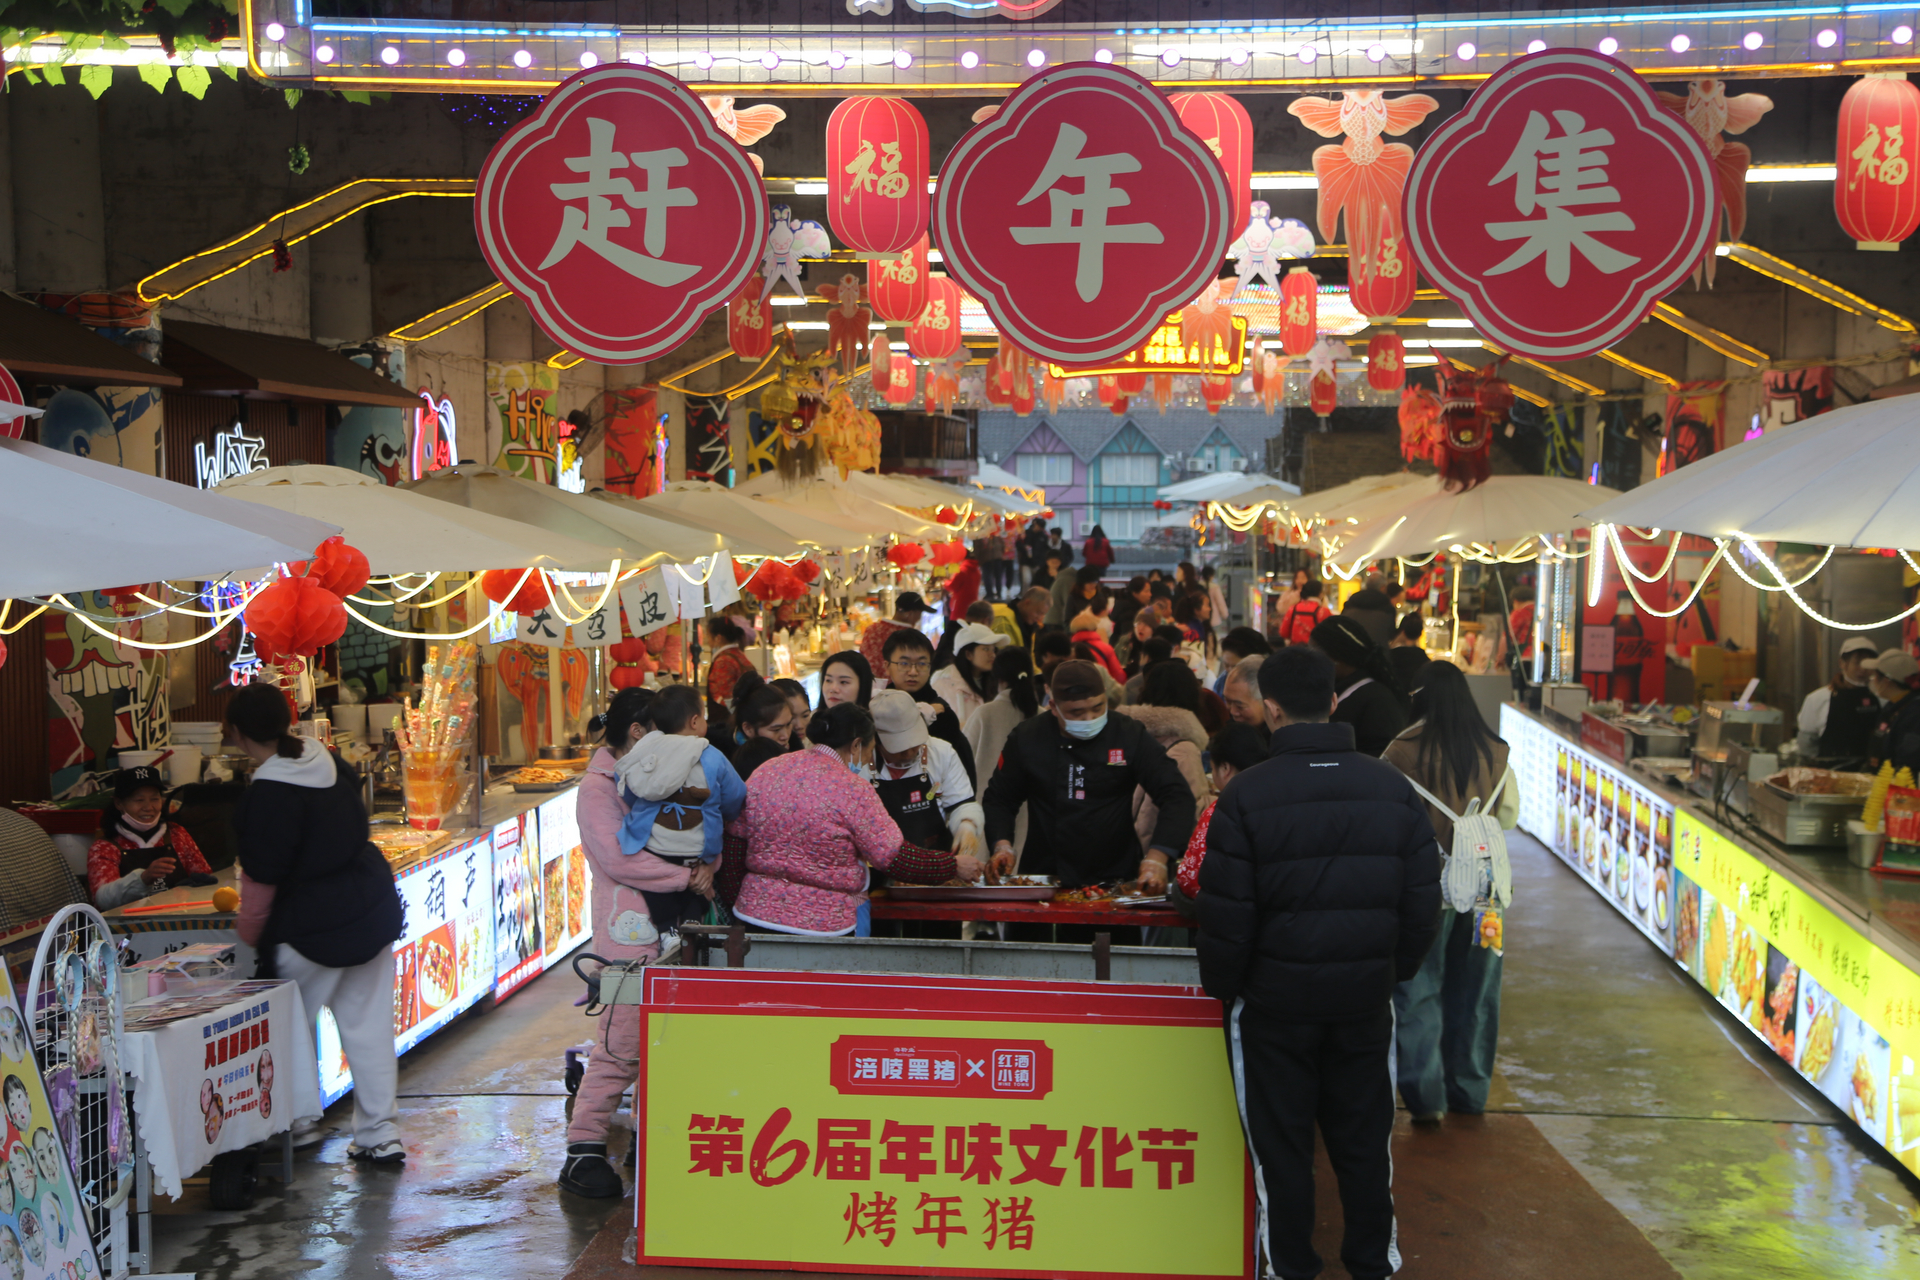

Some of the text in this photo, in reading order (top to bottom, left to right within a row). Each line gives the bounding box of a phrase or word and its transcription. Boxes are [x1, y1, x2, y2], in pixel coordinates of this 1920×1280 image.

[843, 139, 911, 206] 福
[1849, 122, 1910, 192] 福
[537, 109, 1642, 304] 赶 年 集
[877, 250, 919, 289] 福
[735, 298, 765, 333] 福
[912, 299, 951, 334] 福
[1284, 294, 1311, 332] 福
[1372, 348, 1399, 375] 福
[638, 590, 667, 627] 皮
[288, 661, 301, 673] 福
[135, 768, 149, 779] NY
[853, 1057, 956, 1081] 涪陵黑猪
[998, 1054, 1030, 1068] 红酒
[997, 1069, 1030, 1083] 小镇
[687, 1106, 1199, 1190] 第6届年味文化节
[842, 1190, 1036, 1251] 烤年猪
